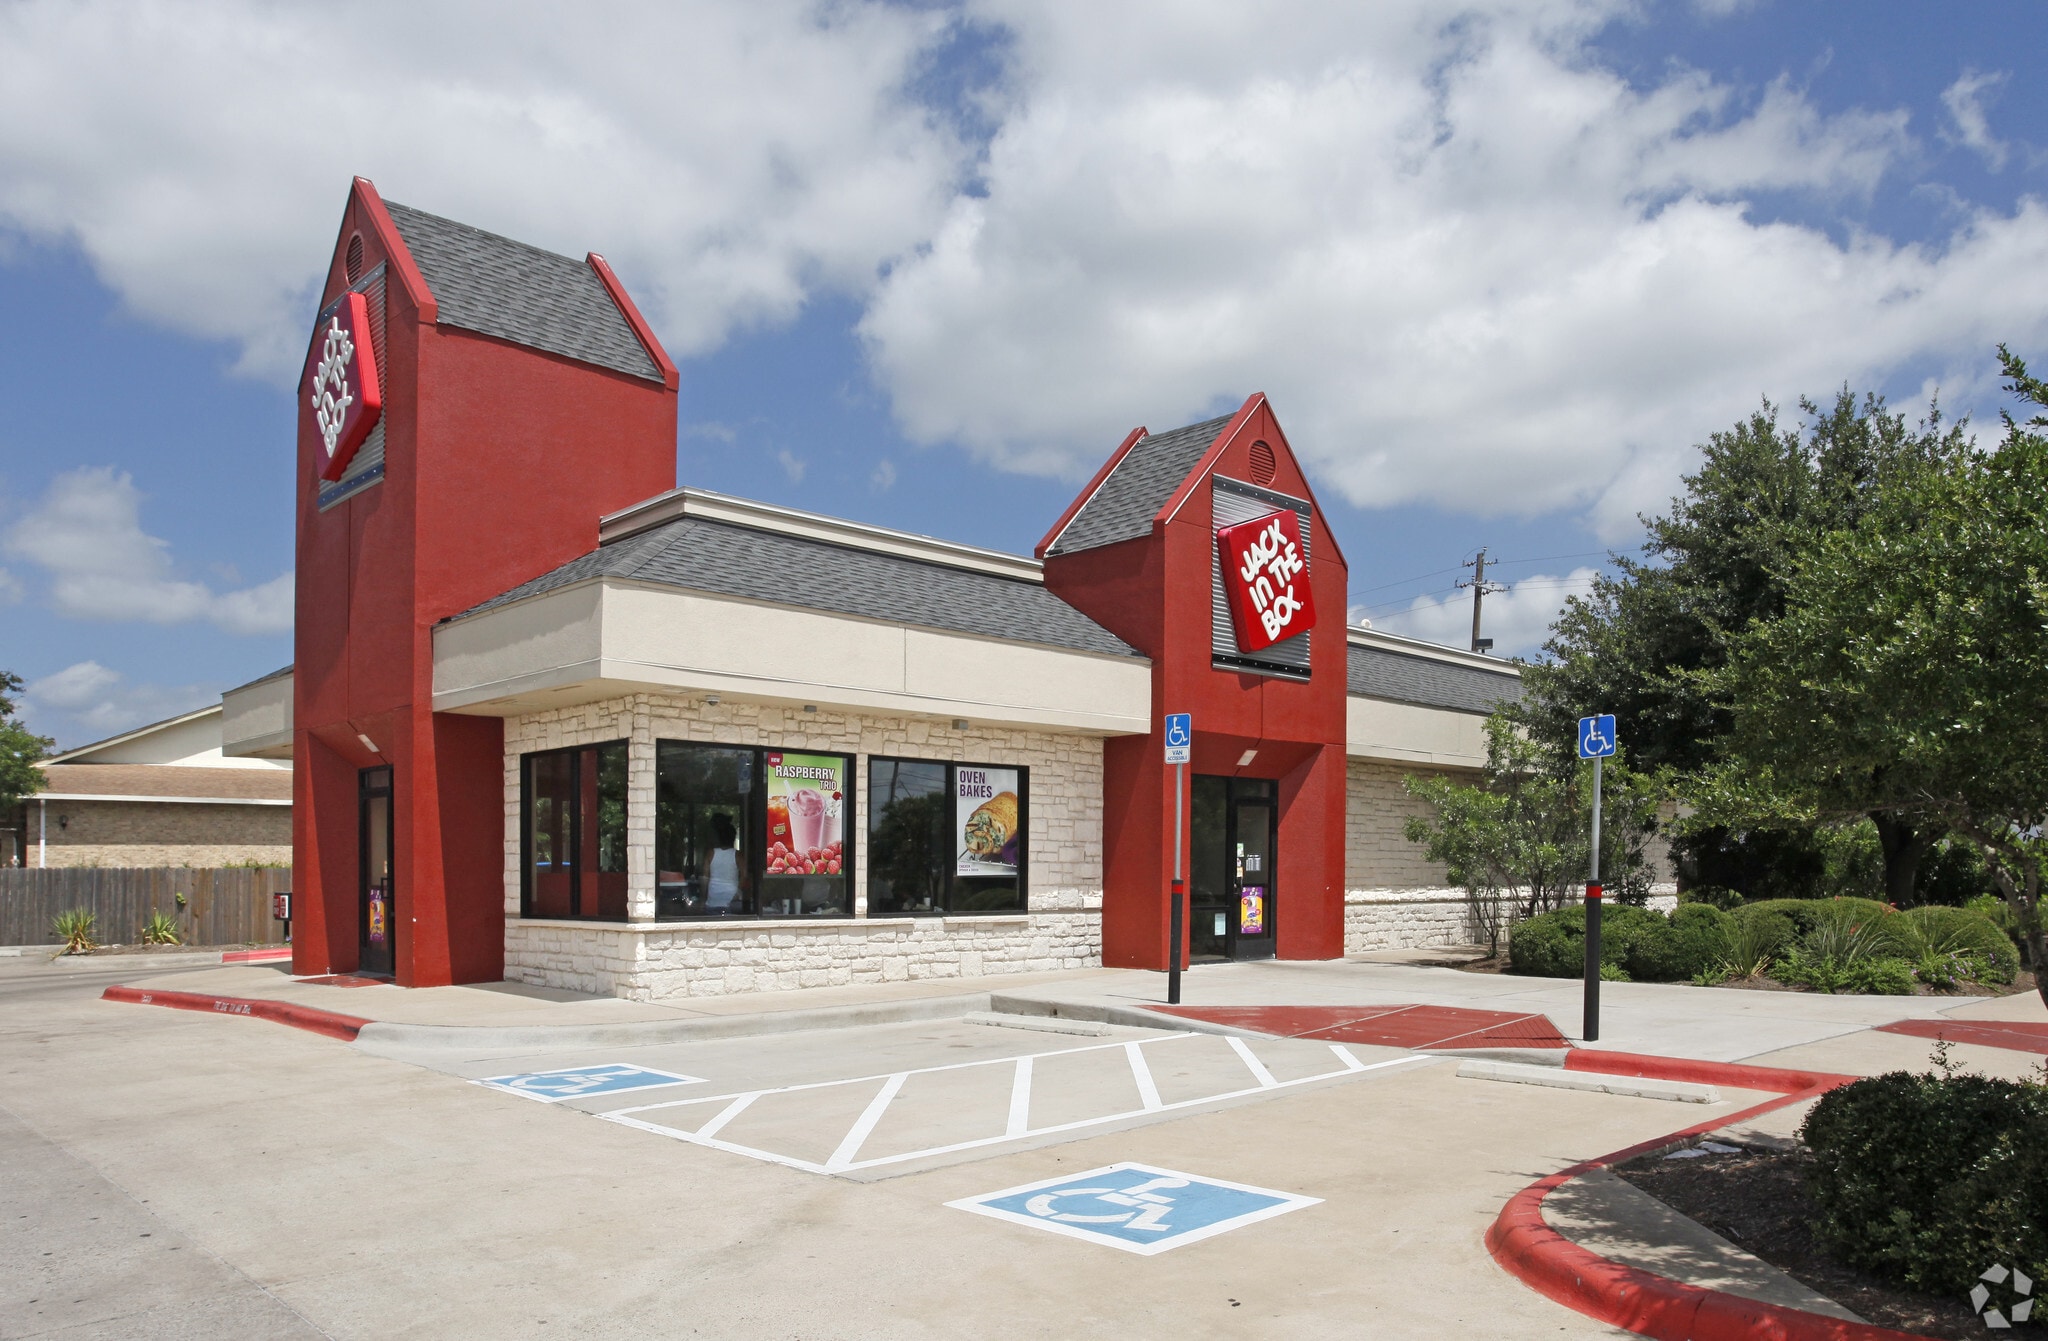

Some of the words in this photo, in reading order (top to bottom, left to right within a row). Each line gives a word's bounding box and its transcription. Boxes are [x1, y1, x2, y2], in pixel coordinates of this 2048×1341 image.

[312, 316, 344, 408] JACK
[317, 391, 335, 435] IN
[330, 329, 354, 391] THE
[324, 380, 353, 458] BOX
[1240, 518, 1288, 582] JACK
[1249, 576, 1275, 613] IN
[1268, 541, 1303, 588] THE
[1261, 585, 1302, 641] BOX
[775, 765, 835, 780] RASPBERRY
[819, 780, 837, 790] TRIO
[960, 770, 985, 784] OVEN
[960, 784, 992, 798] BAKES
